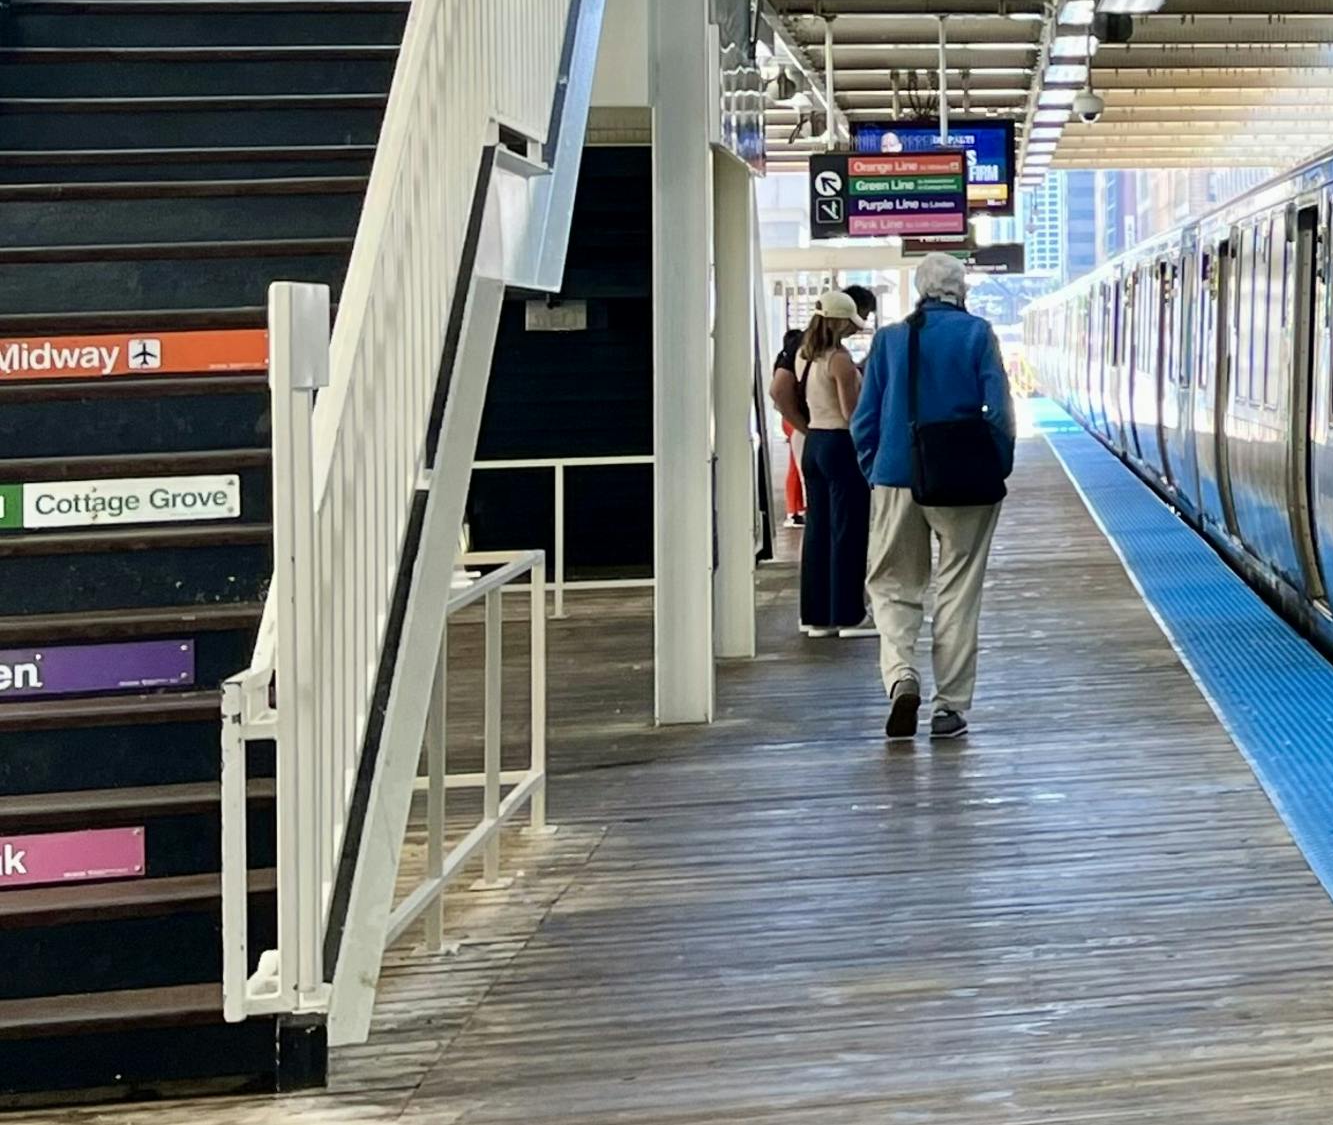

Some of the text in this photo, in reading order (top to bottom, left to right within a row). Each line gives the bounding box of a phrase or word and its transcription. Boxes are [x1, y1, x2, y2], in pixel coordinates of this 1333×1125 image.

[853, 161, 893, 174] Orange
[895, 160, 918, 172] Line
[855, 180, 889, 192] Green
[891, 179, 915, 191] Line
[858, 199, 893, 213] Purple
[895, 197, 919, 210] Line
[0, 342, 121, 375] Midway
[35, 487, 229, 517] Cottage Grove
